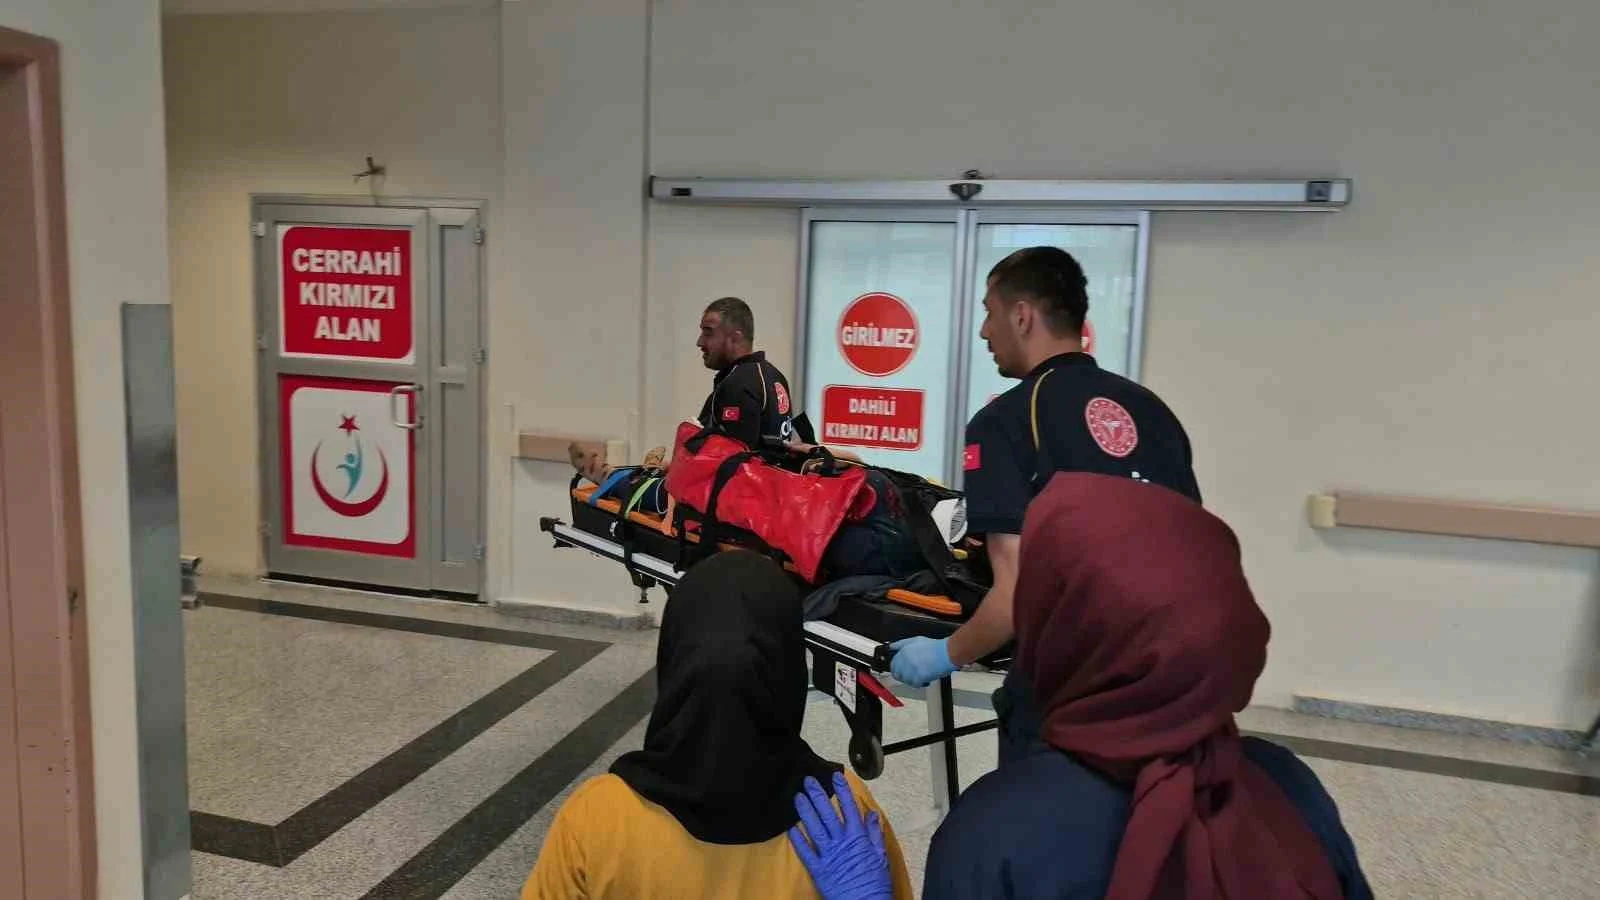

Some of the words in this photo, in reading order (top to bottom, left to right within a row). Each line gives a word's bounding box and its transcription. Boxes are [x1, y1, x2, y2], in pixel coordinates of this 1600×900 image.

[292, 246, 401, 276] CERRAHİ
[299, 282, 396, 310] KIRMIZI
[313, 316, 381, 342] ALAN
[842, 322, 916, 349] GİRİLMEZ
[849, 396, 897, 416] DAHİLİ
[825, 422, 878, 441] KIRMIZI
[880, 426, 919, 444] ALAN
